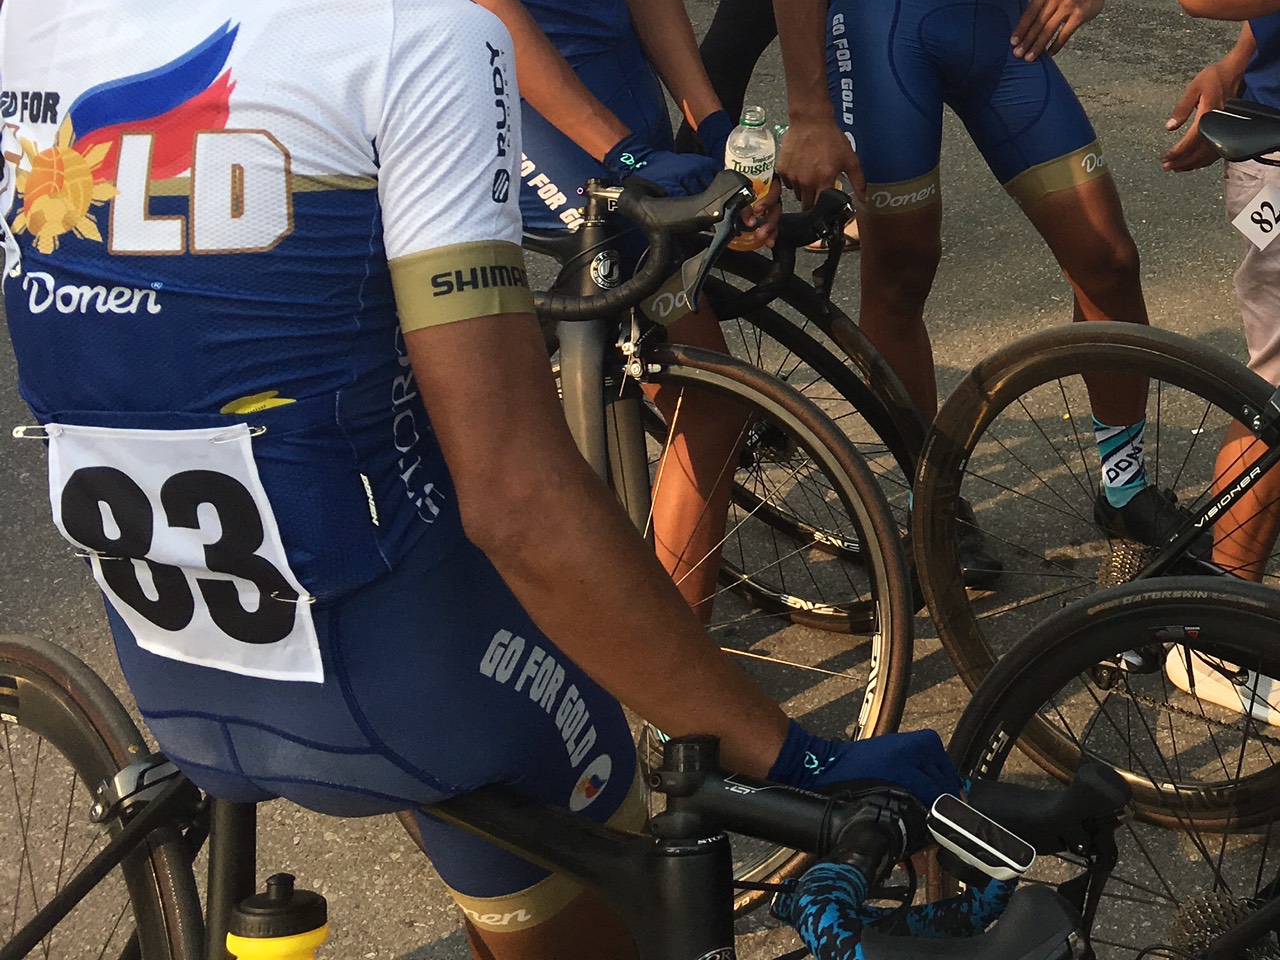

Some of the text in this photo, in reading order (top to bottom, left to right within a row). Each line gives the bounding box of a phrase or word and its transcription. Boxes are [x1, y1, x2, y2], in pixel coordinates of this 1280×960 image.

[832, 13, 845, 36] GO
[832, 38, 852, 73] FOR
[20, 91, 60, 125] FOR
[840, 78, 854, 126] GOLD
[526, 172, 567, 211] FOR
[22, 271, 162, 315] Donen
[1194, 466, 1261, 528] VISIONER
[61, 465, 299, 645] 83
[479, 628, 598, 768] GO FOR GOLD
